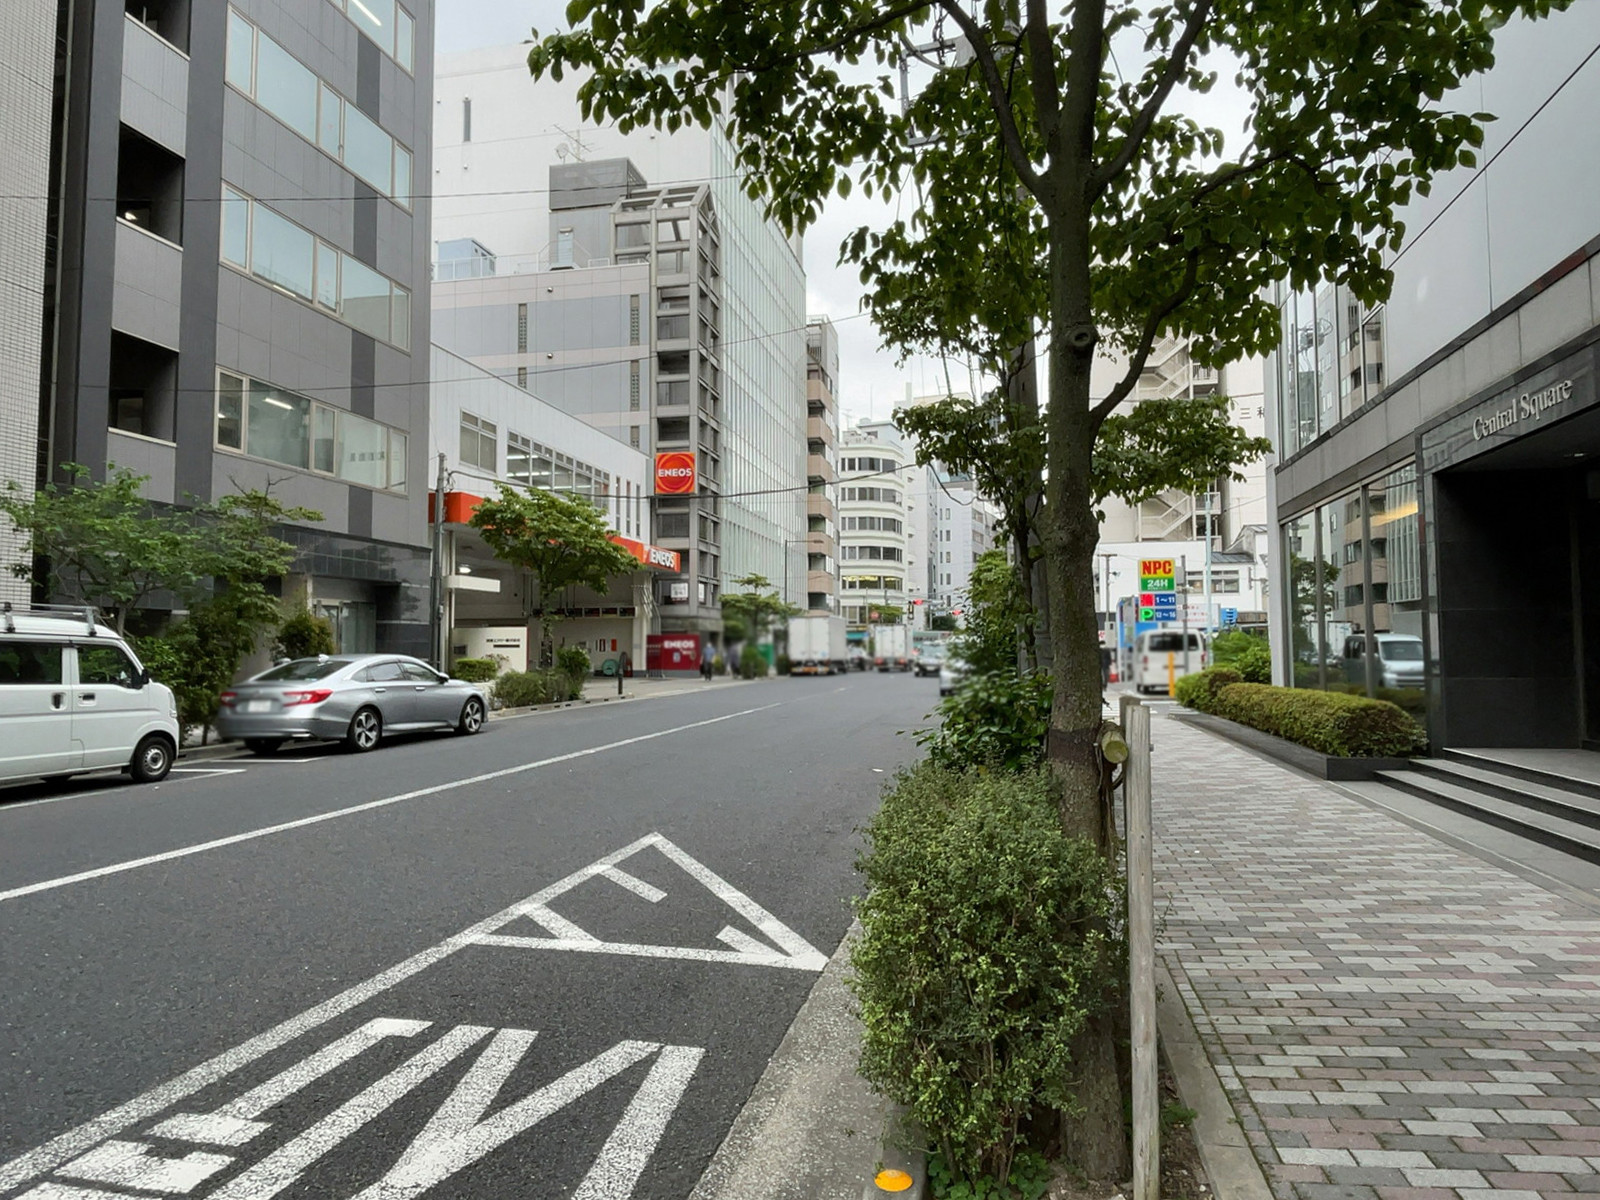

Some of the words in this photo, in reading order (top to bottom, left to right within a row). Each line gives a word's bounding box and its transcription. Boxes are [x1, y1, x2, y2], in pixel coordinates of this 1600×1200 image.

[1473, 398, 1518, 440] Central
[1520, 380, 1573, 420] Square
[658, 468, 692, 477] ENEOS
[649, 548, 675, 568] ENEOS
[1142, 560, 1172, 575] NPC
[1147, 579, 1168, 587] 24H
[1141, 608, 1153, 621] P
[663, 641, 695, 649] ENEOS
